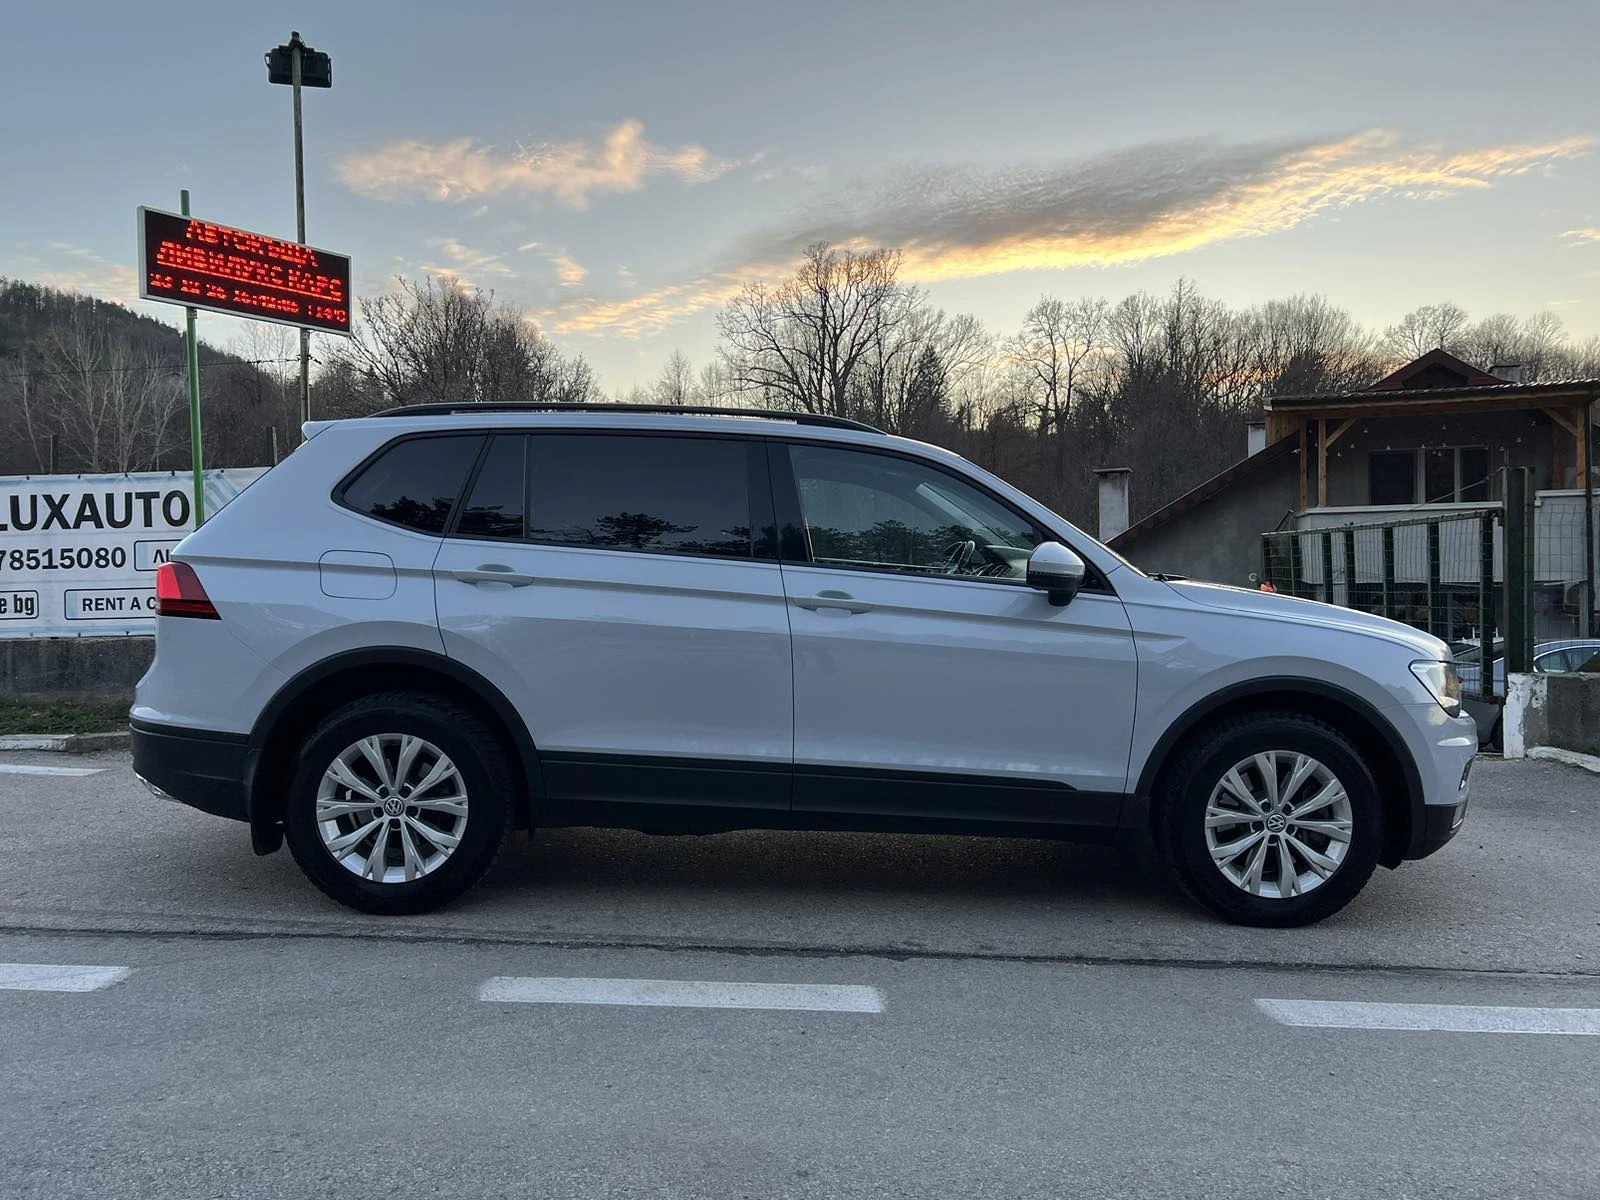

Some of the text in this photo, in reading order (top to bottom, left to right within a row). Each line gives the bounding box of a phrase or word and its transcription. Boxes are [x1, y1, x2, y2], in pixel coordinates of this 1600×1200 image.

[13, 594, 34, 615] bg
[82, 597, 126, 612] RENT
[130, 597, 141, 610] A
